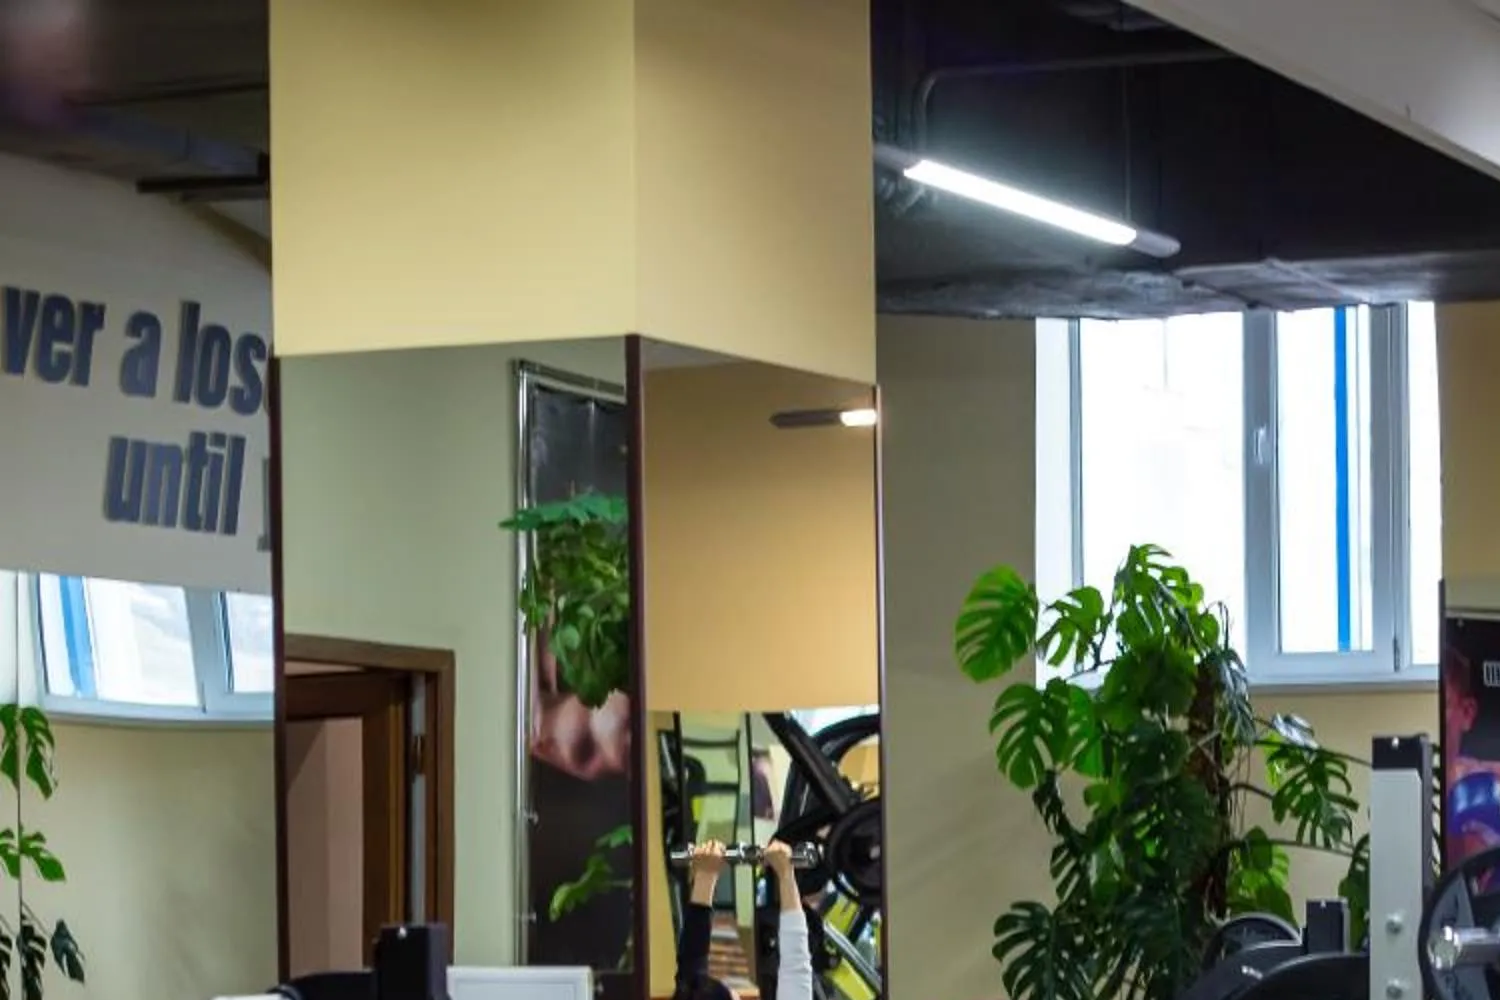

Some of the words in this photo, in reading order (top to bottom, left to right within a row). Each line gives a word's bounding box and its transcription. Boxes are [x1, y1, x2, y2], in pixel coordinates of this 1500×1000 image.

[119, 310, 162, 398] a
[173, 300, 269, 416] los
[103, 431, 246, 536] until
